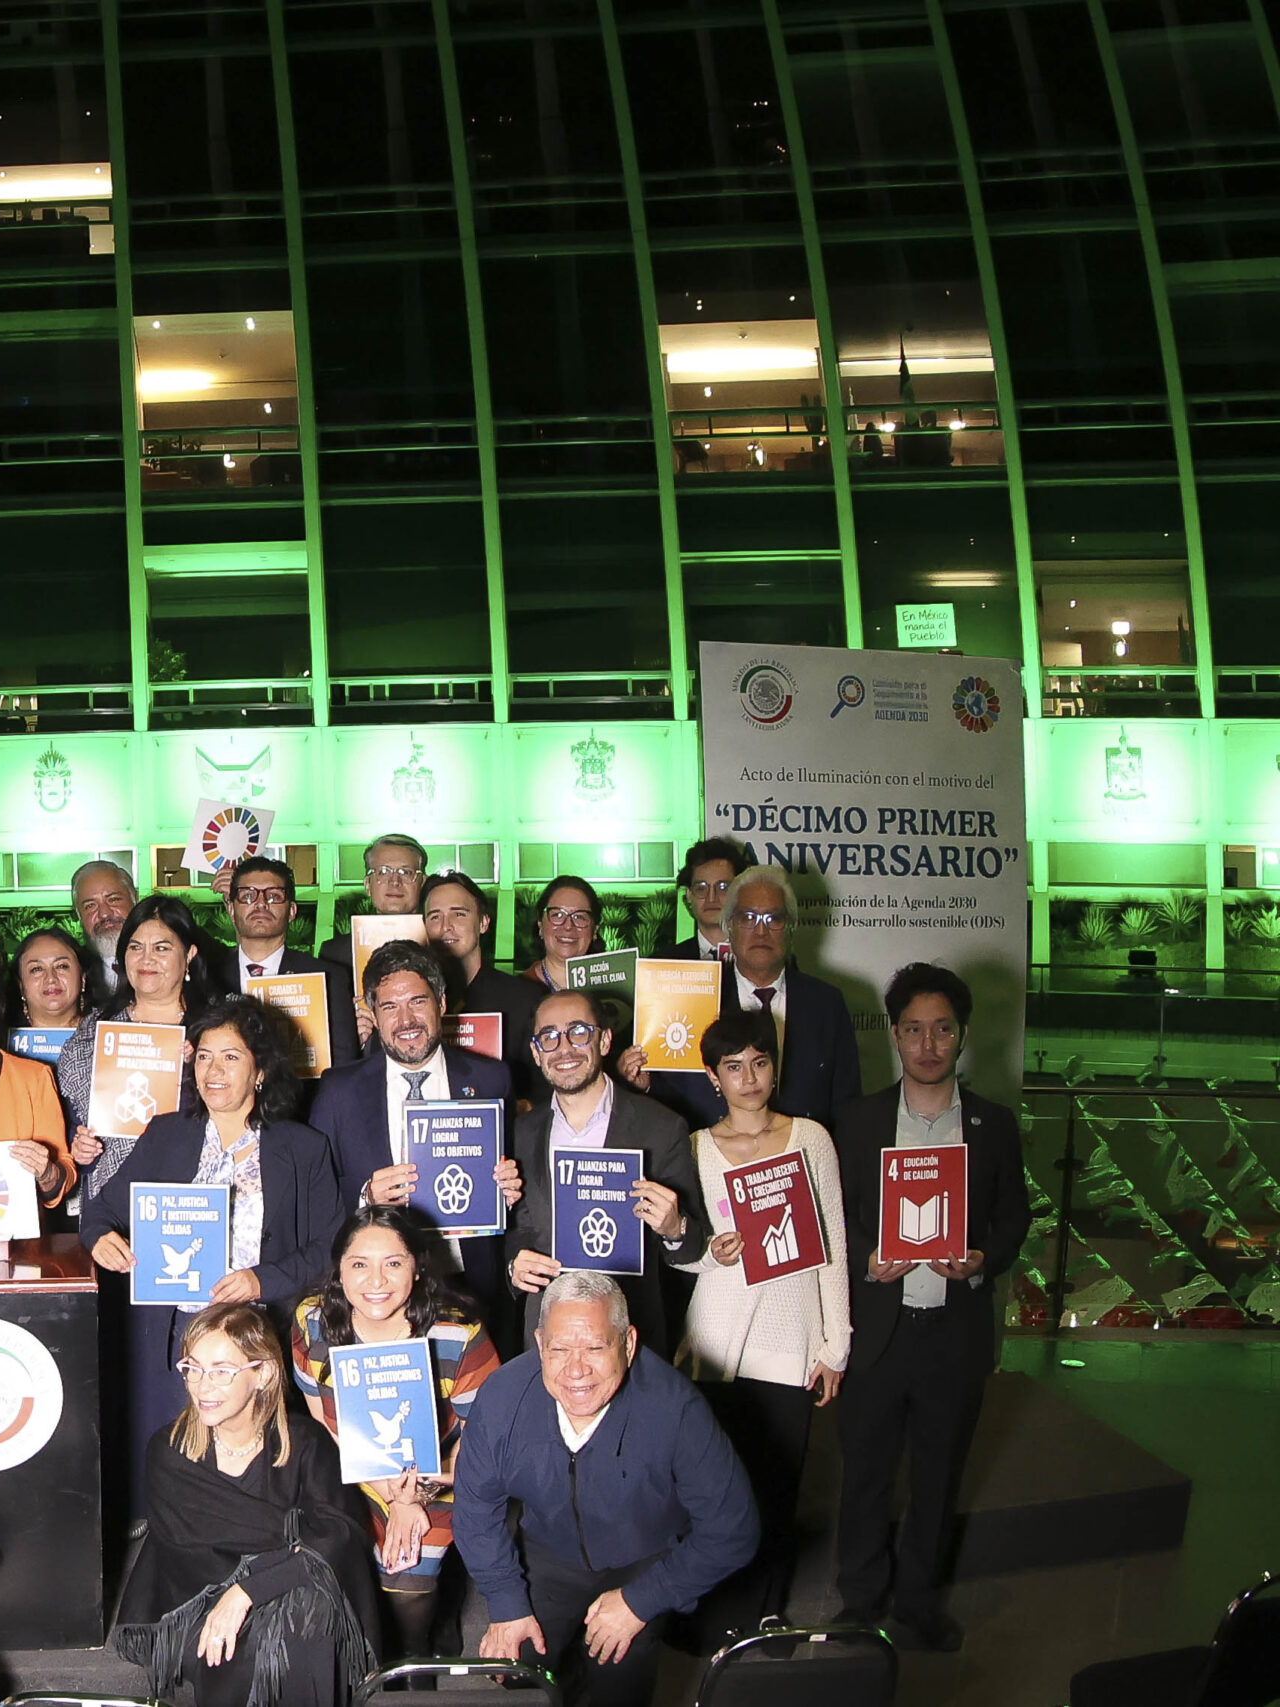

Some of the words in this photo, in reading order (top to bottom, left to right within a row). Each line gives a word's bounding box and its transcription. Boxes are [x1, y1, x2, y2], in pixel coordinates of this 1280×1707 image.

[902, 610, 916, 622] En
[904, 622, 935, 631] manda
[939, 621, 947, 631] el
[910, 630, 944, 642] pueblo
[909, 710, 928, 723] 2030
[740, 767, 772, 782] Acto
[776, 767, 794, 783] de
[798, 767, 882, 785] Iluminación
[885, 775, 910, 786] con
[913, 771, 924, 786] el
[928, 772, 972, 787] motivo
[975, 773, 994, 789] del
[877, 807, 998, 838] PRIMER
[871, 895, 885, 908] de
[888, 895, 898, 908] la
[901, 896, 946, 911] Agenda
[949, 896, 977, 908] 2030
[825, 913, 838, 927] de
[842, 914, 906, 928] Desarrollo
[909, 915, 968, 929] sostenible
[971, 916, 1006, 930] (ODS)
[590, 961, 610, 973] ACCIÓN
[571, 965, 586, 988] 13
[590, 975, 600, 986] POR
[601, 974, 608, 984] EL
[609, 971, 627, 983] CLIMA
[252, 986, 264, 1006] 11
[13, 1035, 28, 1053] 14
[103, 1031, 115, 1056] 9
[411, 1118, 429, 1144] 17
[431, 1118, 463, 1130] ALIANZAS
[464, 1117, 482, 1128] PARA
[431, 1132, 459, 1144] LOGRAR
[432, 1146, 446, 1158] LOS
[447, 1145, 482, 1157] OBJETIVOS
[577, 1160, 608, 1173] ALIANZAS
[609, 1161, 626, 1173] PARA
[903, 1154, 938, 1167] EDUCACIÓN
[558, 1160, 574, 1185] 17
[744, 1168, 773, 1187] TRABAJO
[772, 1160, 800, 1179] DECENTE
[888, 1158, 899, 1181] 4
[903, 1171, 912, 1181] DE
[912, 1169, 939, 1180] CALIDAD
[577, 1174, 603, 1186] LOGRAR
[748, 1187, 754, 1196] Y
[753, 1176, 793, 1195] CRECIMIENTO
[577, 1188, 591, 1200] LOS
[591, 1189, 626, 1201] OBJETIVOS
[732, 1177, 746, 1204] 8
[137, 1195, 158, 1222] 16
[177, 1195, 209, 1208] JUSTICIA
[750, 1193, 786, 1213] ECONÓMICO
[162, 1210, 167, 1221] E
[168, 1210, 220, 1222] INSTITUCIONES
[379, 1354, 410, 1368] JUSTICIA
[338, 1358, 360, 1388] 16
[365, 1374, 371, 1384] E
